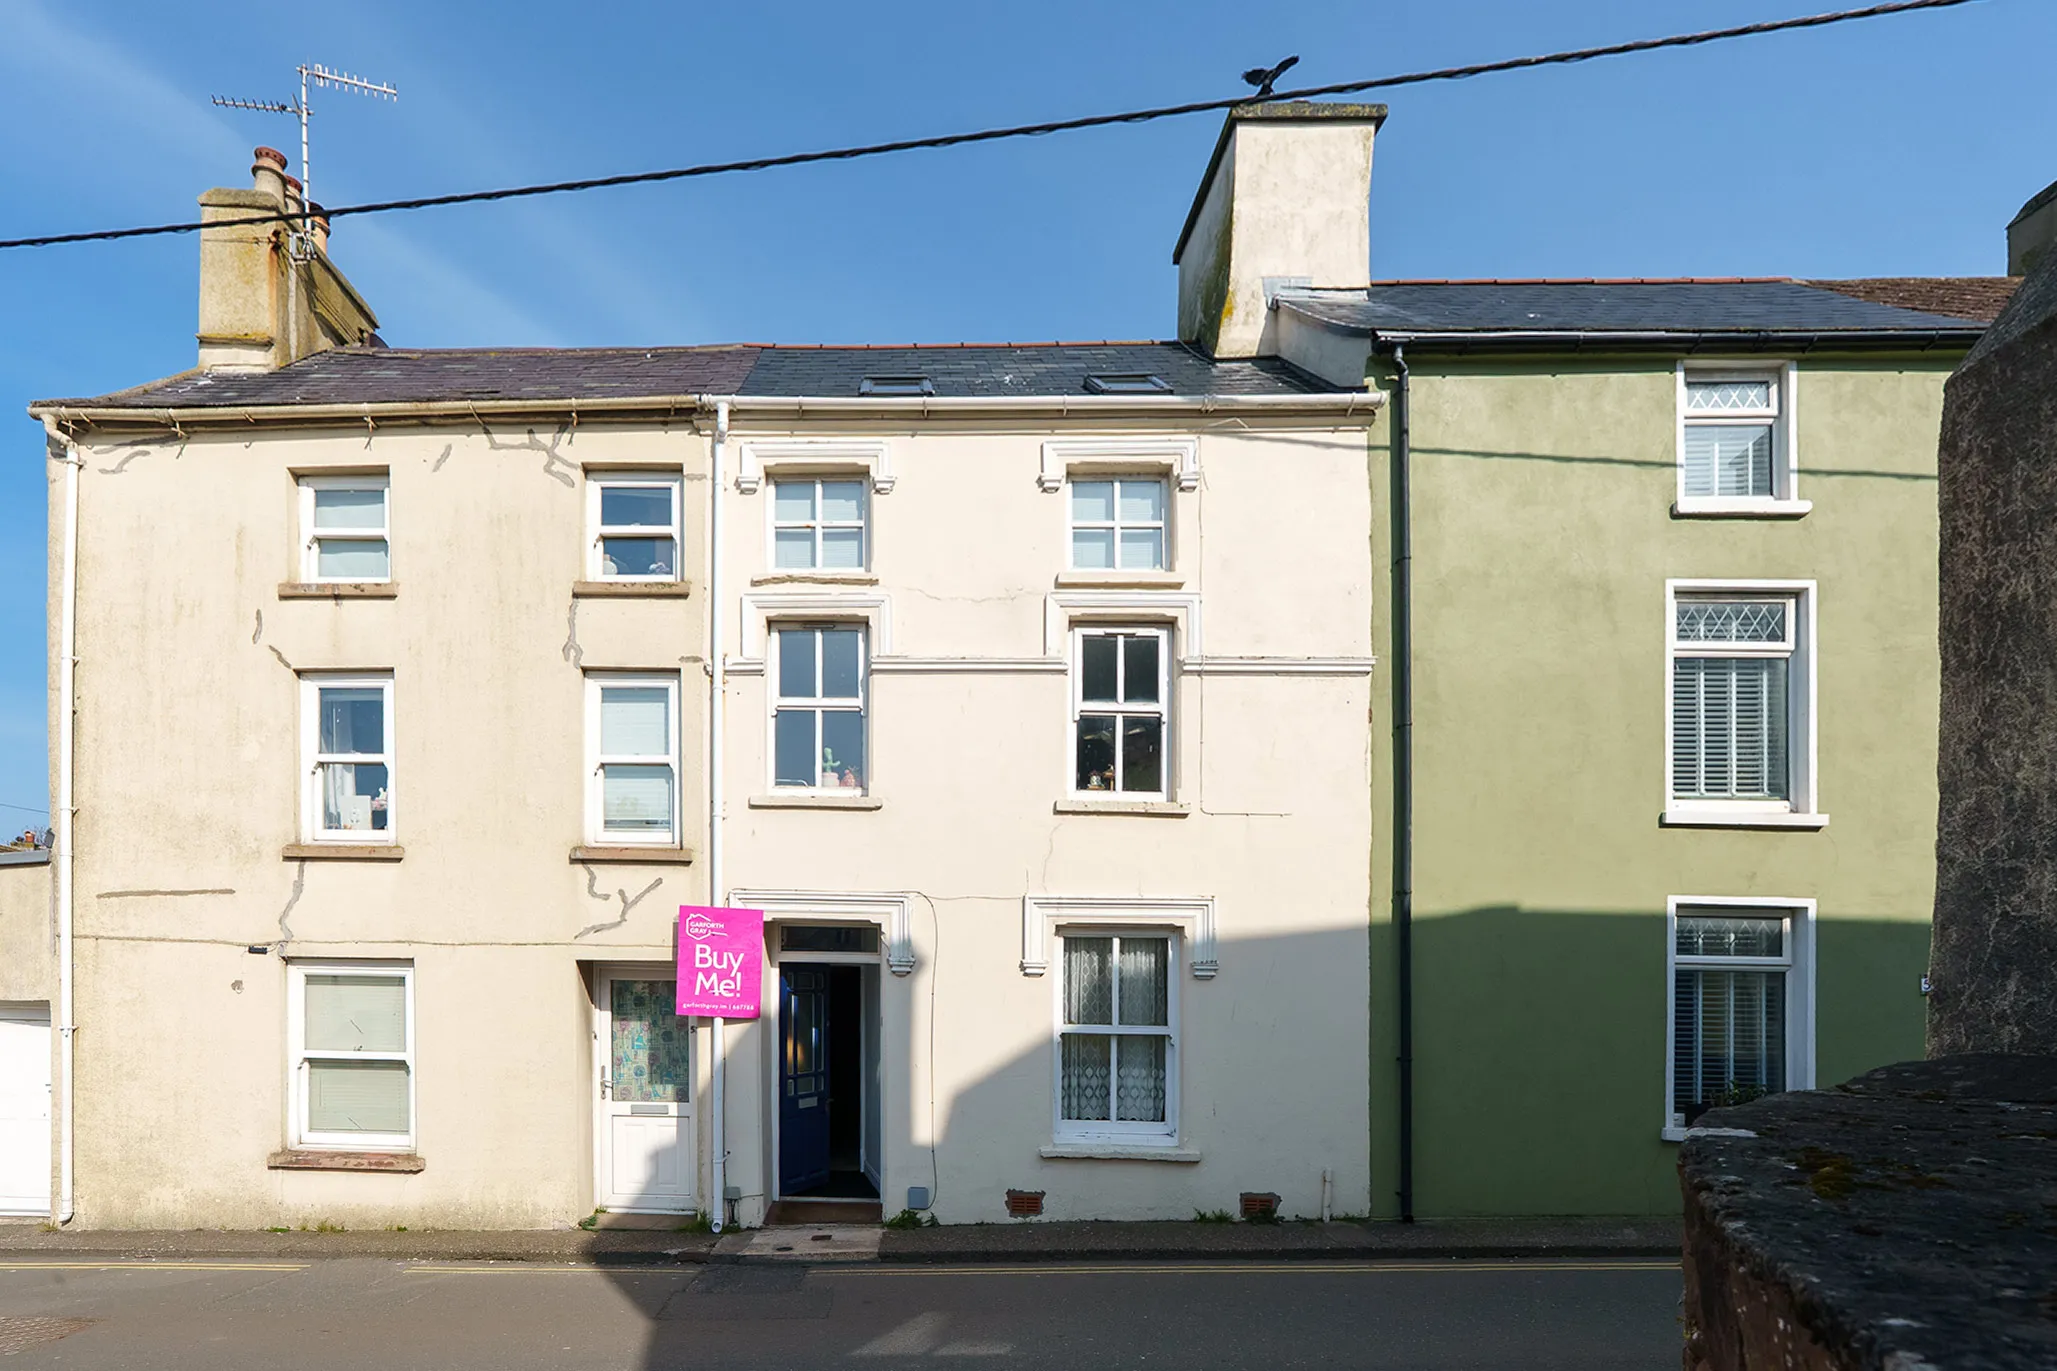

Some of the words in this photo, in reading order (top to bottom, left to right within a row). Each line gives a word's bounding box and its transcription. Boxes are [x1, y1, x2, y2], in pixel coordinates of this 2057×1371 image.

[690, 921, 725, 929] GARFORTH
[695, 943, 745, 977] Buy
[694, 971, 742, 998] Me!
